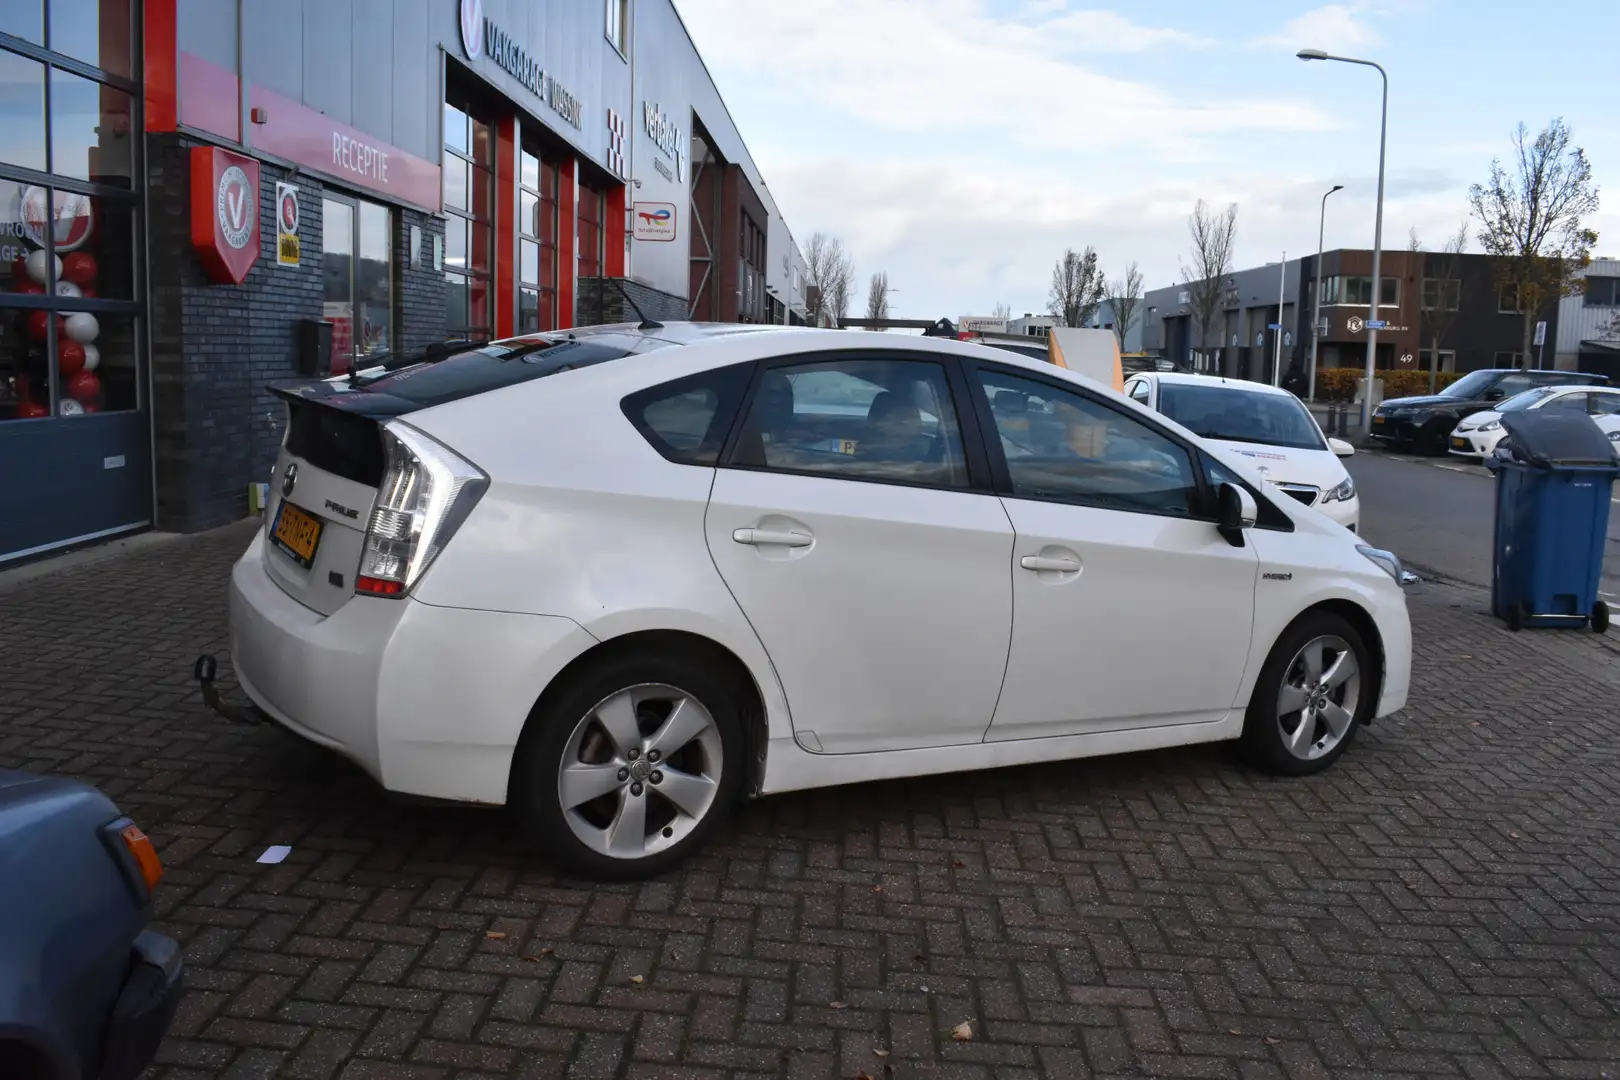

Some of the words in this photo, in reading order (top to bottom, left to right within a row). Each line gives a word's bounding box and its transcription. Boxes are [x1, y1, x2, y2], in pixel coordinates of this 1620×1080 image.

[483, 16, 547, 101] VAKGARAGE
[333, 131, 388, 183] RECEPTIE
[1400, 354, 1413, 363] 49
